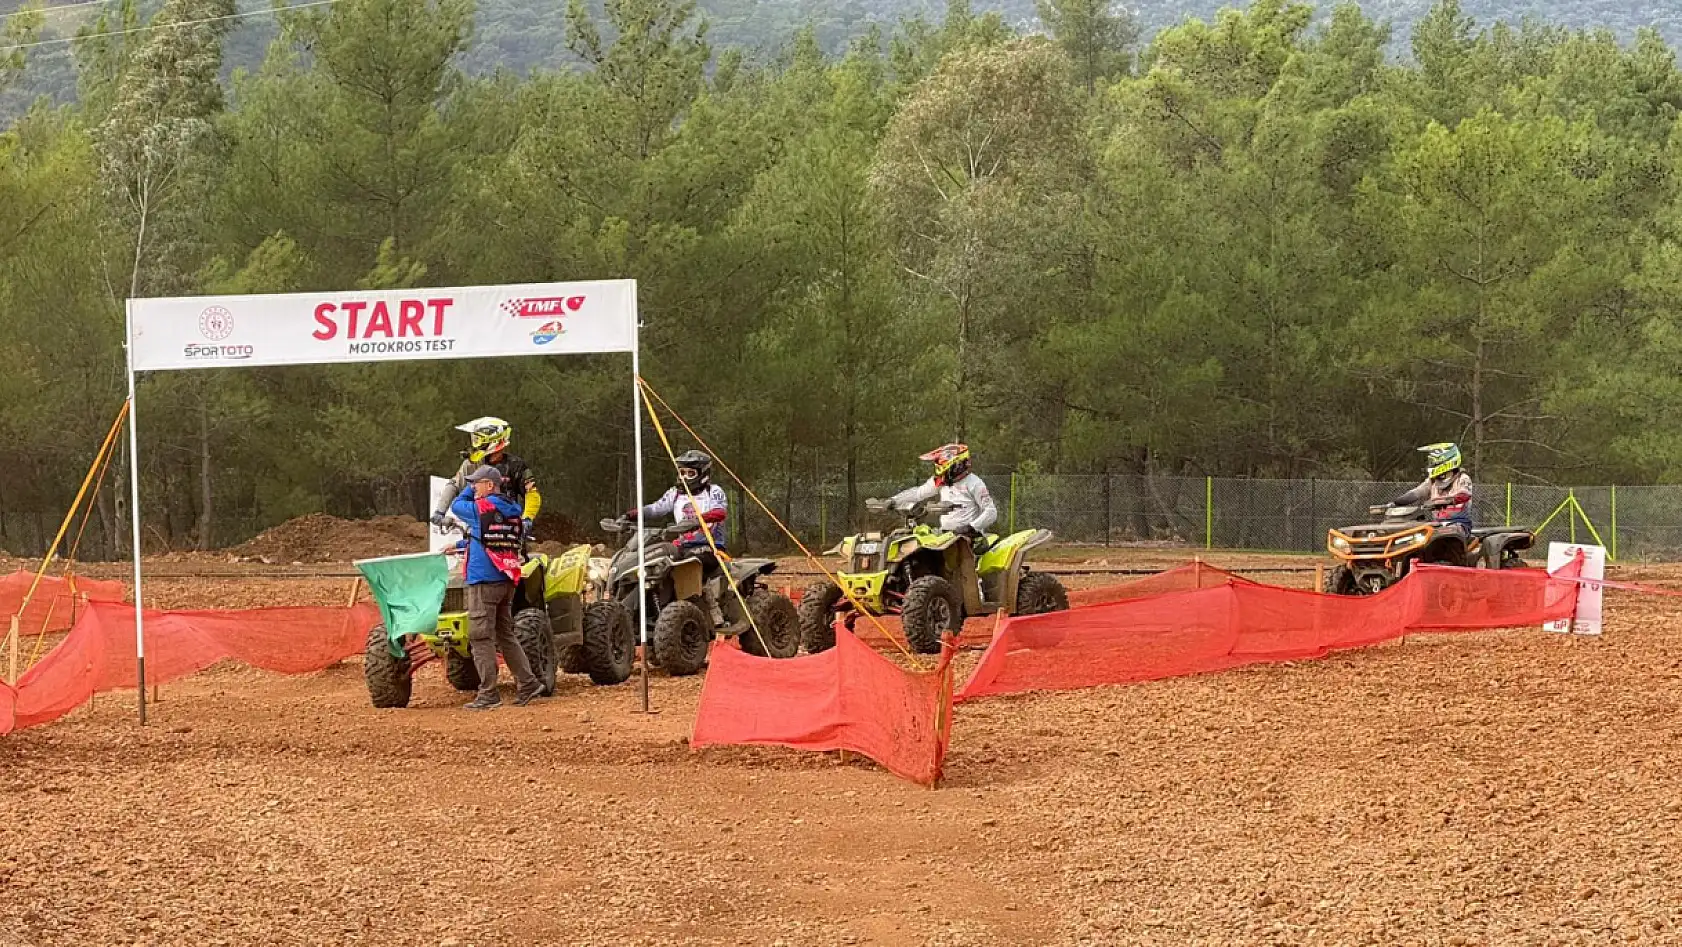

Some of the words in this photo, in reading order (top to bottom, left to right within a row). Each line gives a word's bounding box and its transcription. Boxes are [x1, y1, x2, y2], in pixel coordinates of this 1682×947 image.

[527, 300, 562, 313] TMF
[311, 297, 454, 340] START
[349, 340, 422, 354] MOTOKROS
[425, 339, 455, 352] TEST
